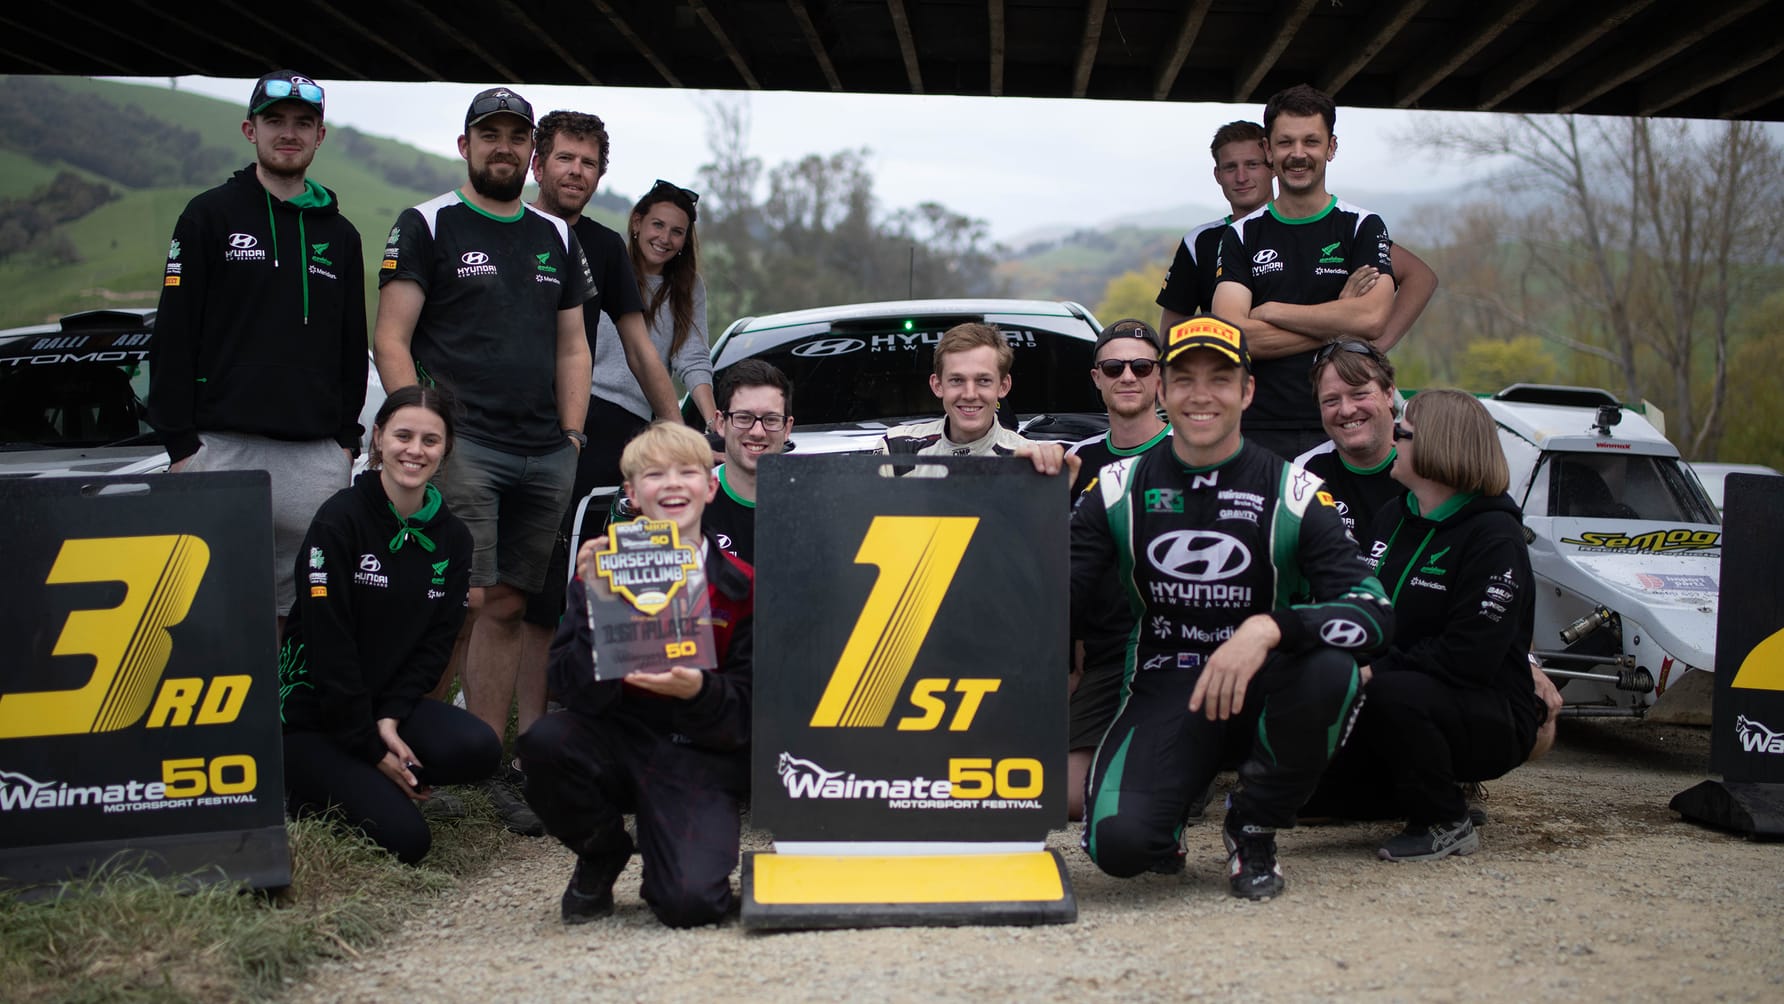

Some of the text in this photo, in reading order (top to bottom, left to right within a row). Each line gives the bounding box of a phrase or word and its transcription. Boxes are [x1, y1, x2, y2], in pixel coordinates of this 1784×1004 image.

[457, 265, 497, 276] HYUNDAI
[32, 334, 152, 350] RALLI ART
[871, 331, 1035, 347] HYUAI
[871, 344, 917, 353] NEW
[0, 351, 150, 366] TOMOT
[1192, 470, 1219, 489] N
[1219, 509, 1258, 521] GRAVITY
[600, 551, 692, 569] HORSEPOWER
[354, 571, 388, 584] HUNDAI
[614, 567, 683, 586] HILLCLIMB
[1149, 581, 1252, 601] HYUNDAI
[1184, 600, 1252, 609] ZEALAND
[1181, 624, 1236, 643] Meridi
[665, 640, 697, 660] 50
[103, 793, 257, 813] MOTORSPORT FESTIVAL
[889, 800, 1043, 810] MOTORSPORT FESTIVAL
